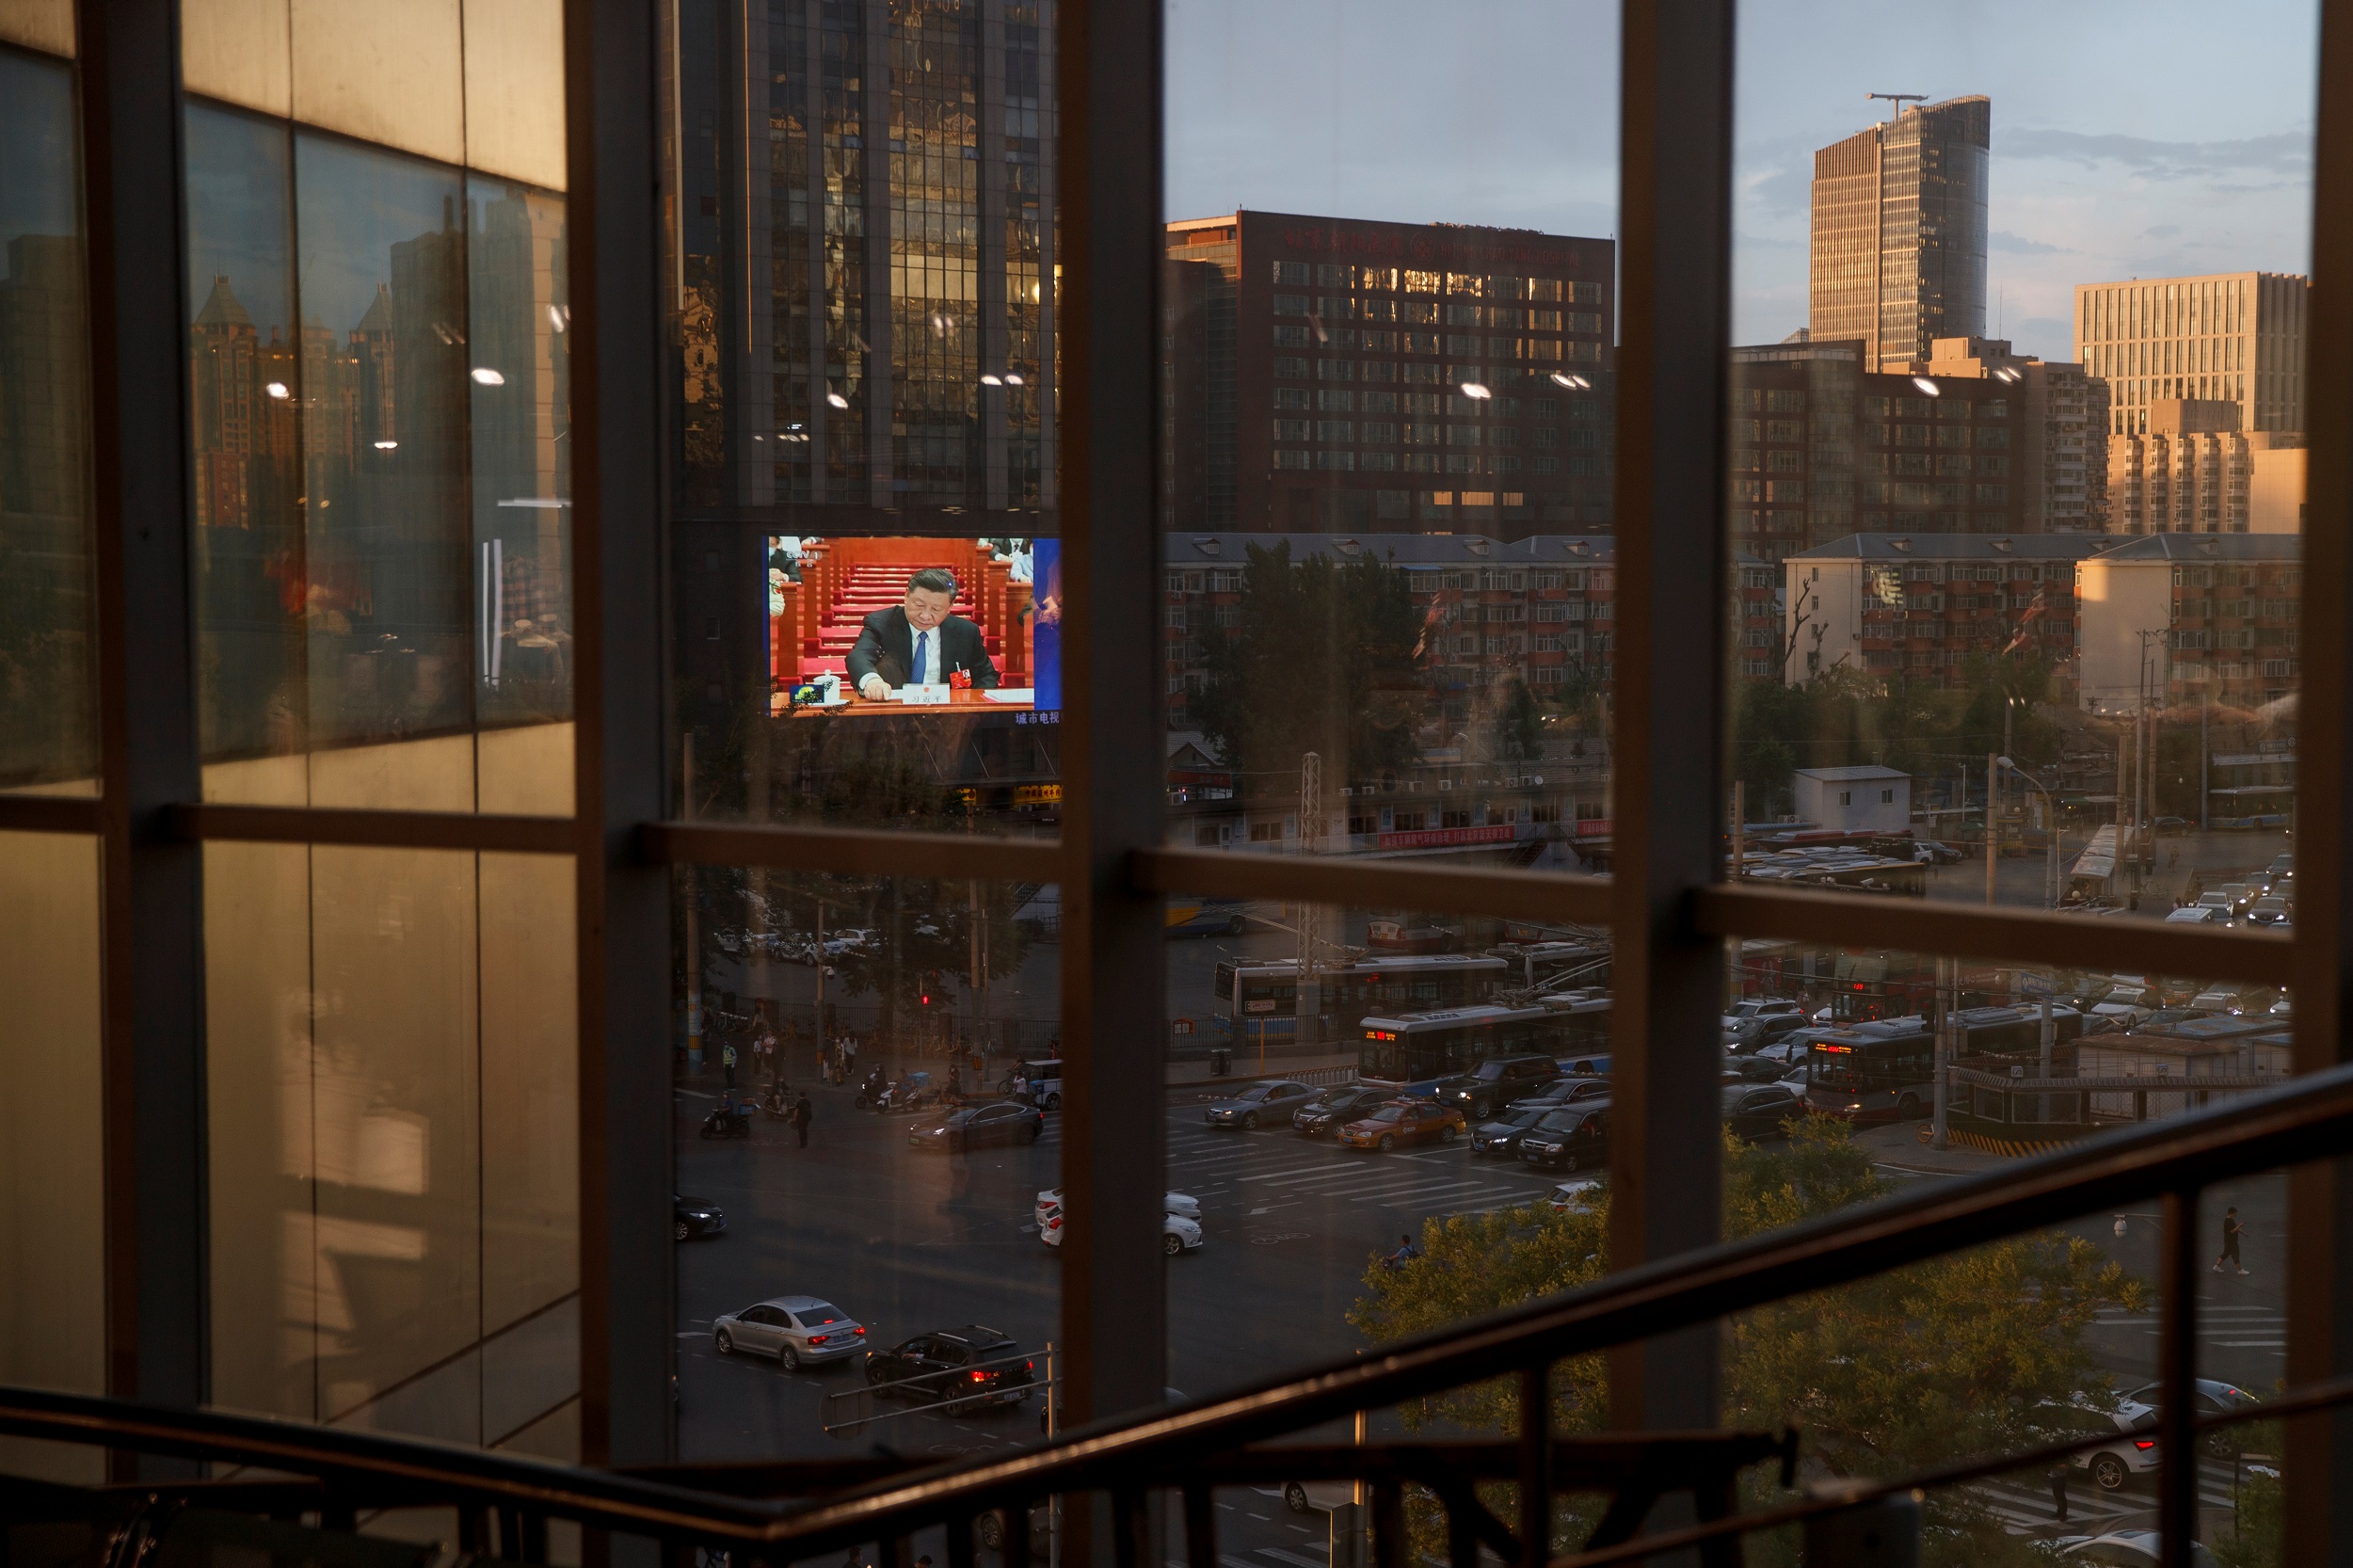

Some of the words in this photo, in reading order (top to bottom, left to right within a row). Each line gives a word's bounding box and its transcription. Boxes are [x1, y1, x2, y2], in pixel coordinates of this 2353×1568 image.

[787, 551, 809, 559] CCTV
[1016, 712, 1060, 725] 城市电视
